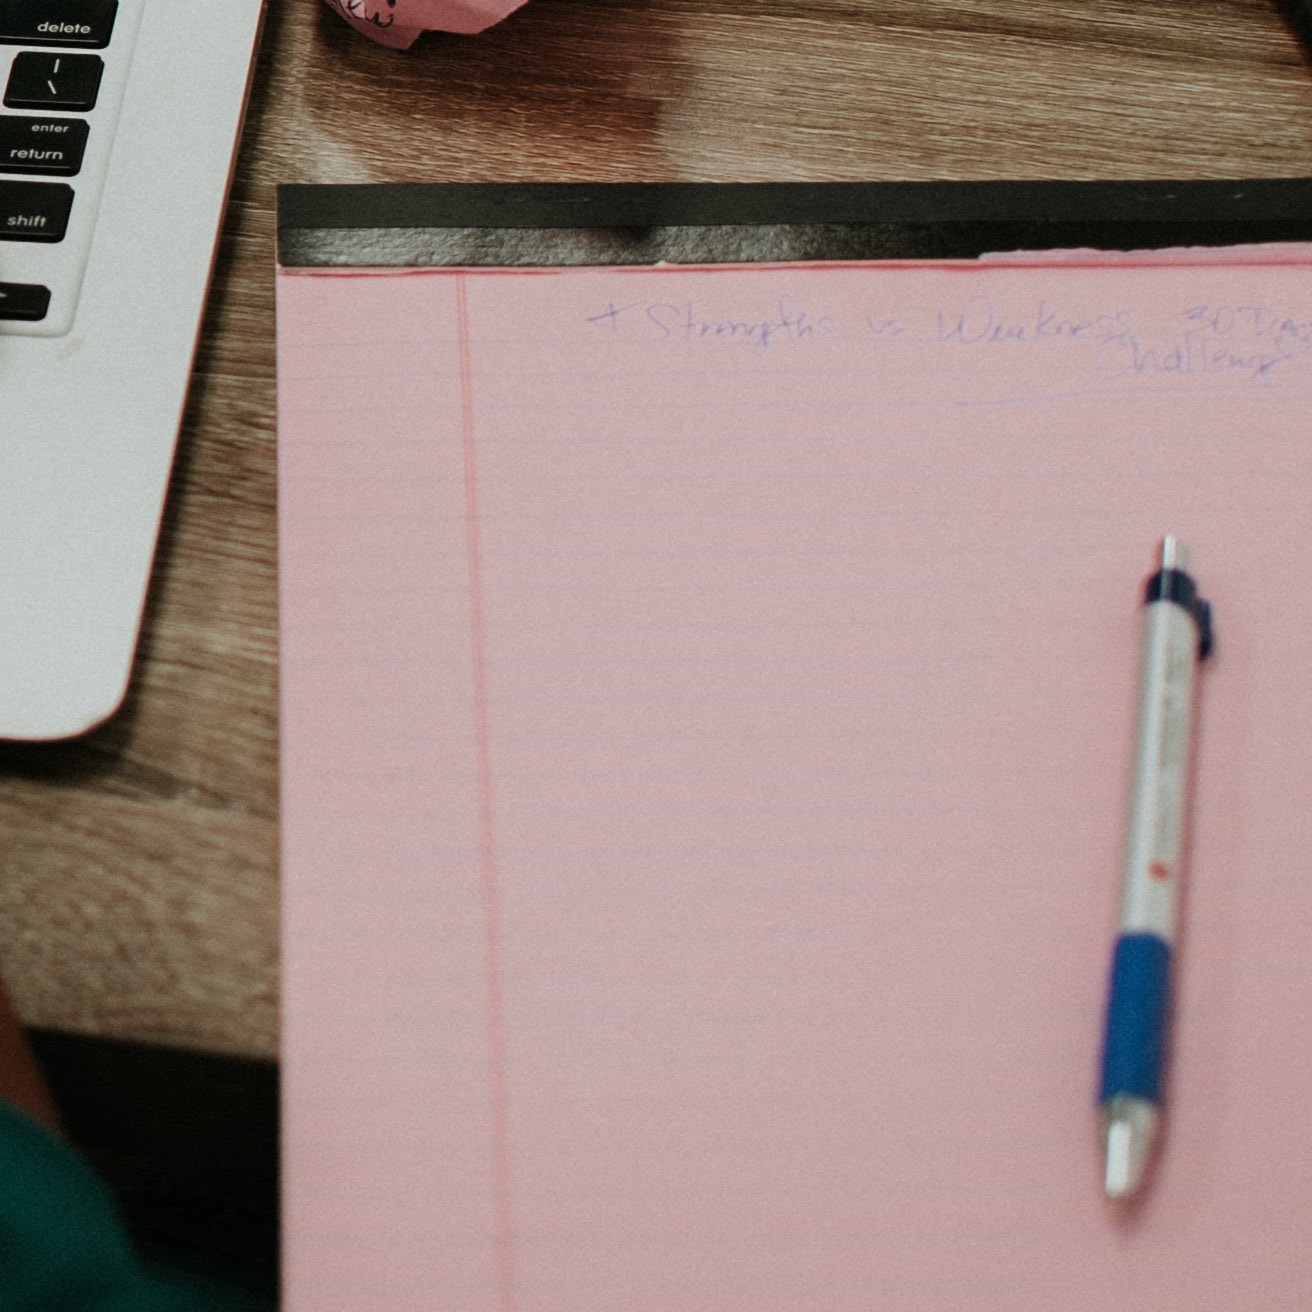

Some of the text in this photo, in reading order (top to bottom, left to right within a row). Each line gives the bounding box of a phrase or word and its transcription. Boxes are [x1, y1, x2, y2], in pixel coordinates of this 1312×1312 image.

[37, 21, 91, 34] delete
[31, 123, 69, 134] enter
[10, 148, 63, 161] return
[7, 213, 47, 228] shift
